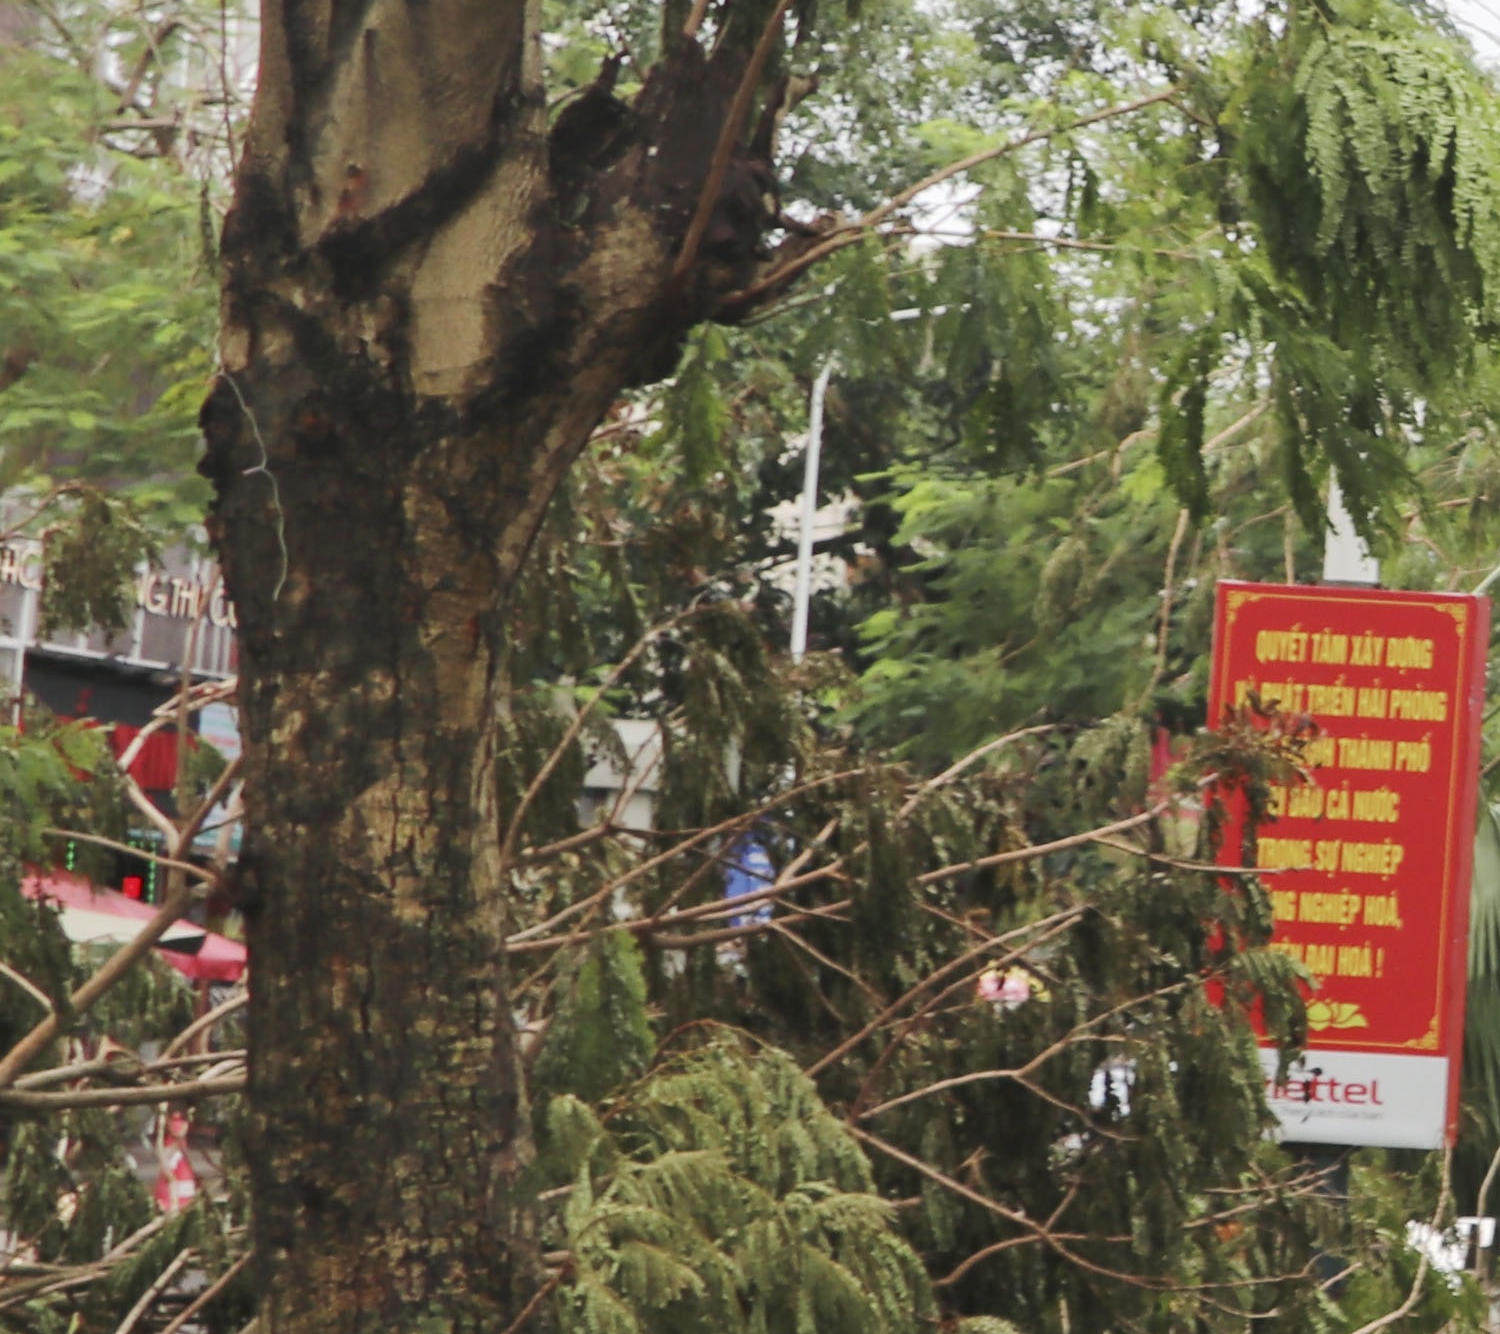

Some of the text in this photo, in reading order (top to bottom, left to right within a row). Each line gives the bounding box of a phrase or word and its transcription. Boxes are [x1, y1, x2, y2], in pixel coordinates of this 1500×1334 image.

[1256, 623, 1434, 675] QUYẾT TÂM XÂY DỰNG
[1307, 674, 1355, 716] TRIỂN
[1357, 678, 1387, 718] HẢI
[1389, 683, 1448, 722] PHÒNG
[1338, 733, 1394, 771] THÀNH
[1395, 732, 1431, 773] PHỐ
[1326, 780, 1349, 820] CẢ
[1352, 786, 1399, 823] NƯỚC
[1257, 837, 1404, 881] TRONG SỰ NGHIỆP
[1299, 887, 1361, 931] NGHIỆP
[1363, 890, 1403, 930] HOÁ,
[1337, 940, 1373, 977] HOÁ
[1375, 947, 1384, 978] !
[1265, 1074, 1383, 1106] iettel
